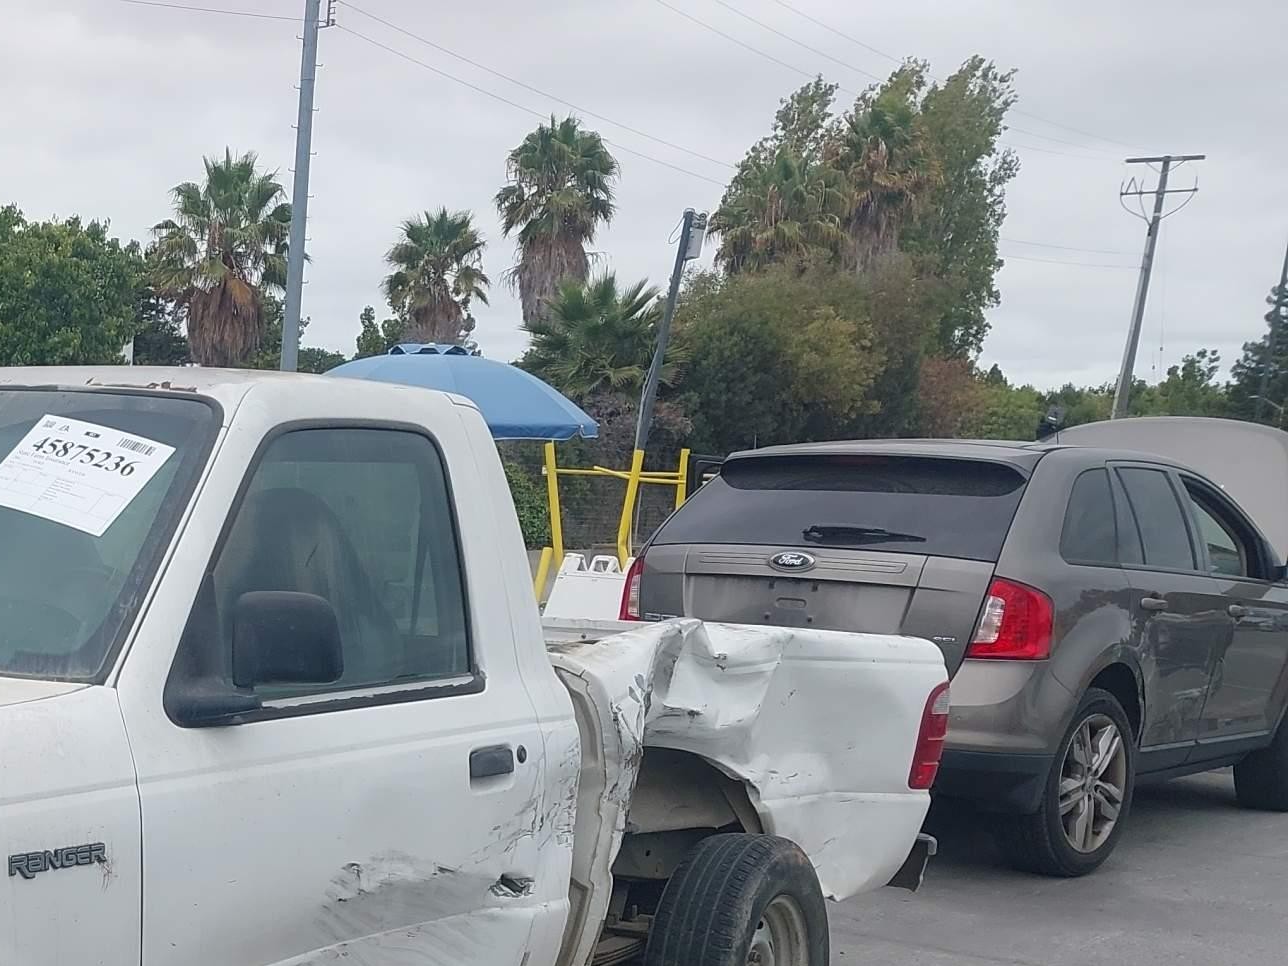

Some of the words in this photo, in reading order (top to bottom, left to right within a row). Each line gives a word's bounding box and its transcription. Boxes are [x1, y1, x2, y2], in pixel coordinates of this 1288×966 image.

[32, 436, 142, 477] 45875236
[778, 553, 804, 565] Ford
[7, 842, 107, 880] RANGER
